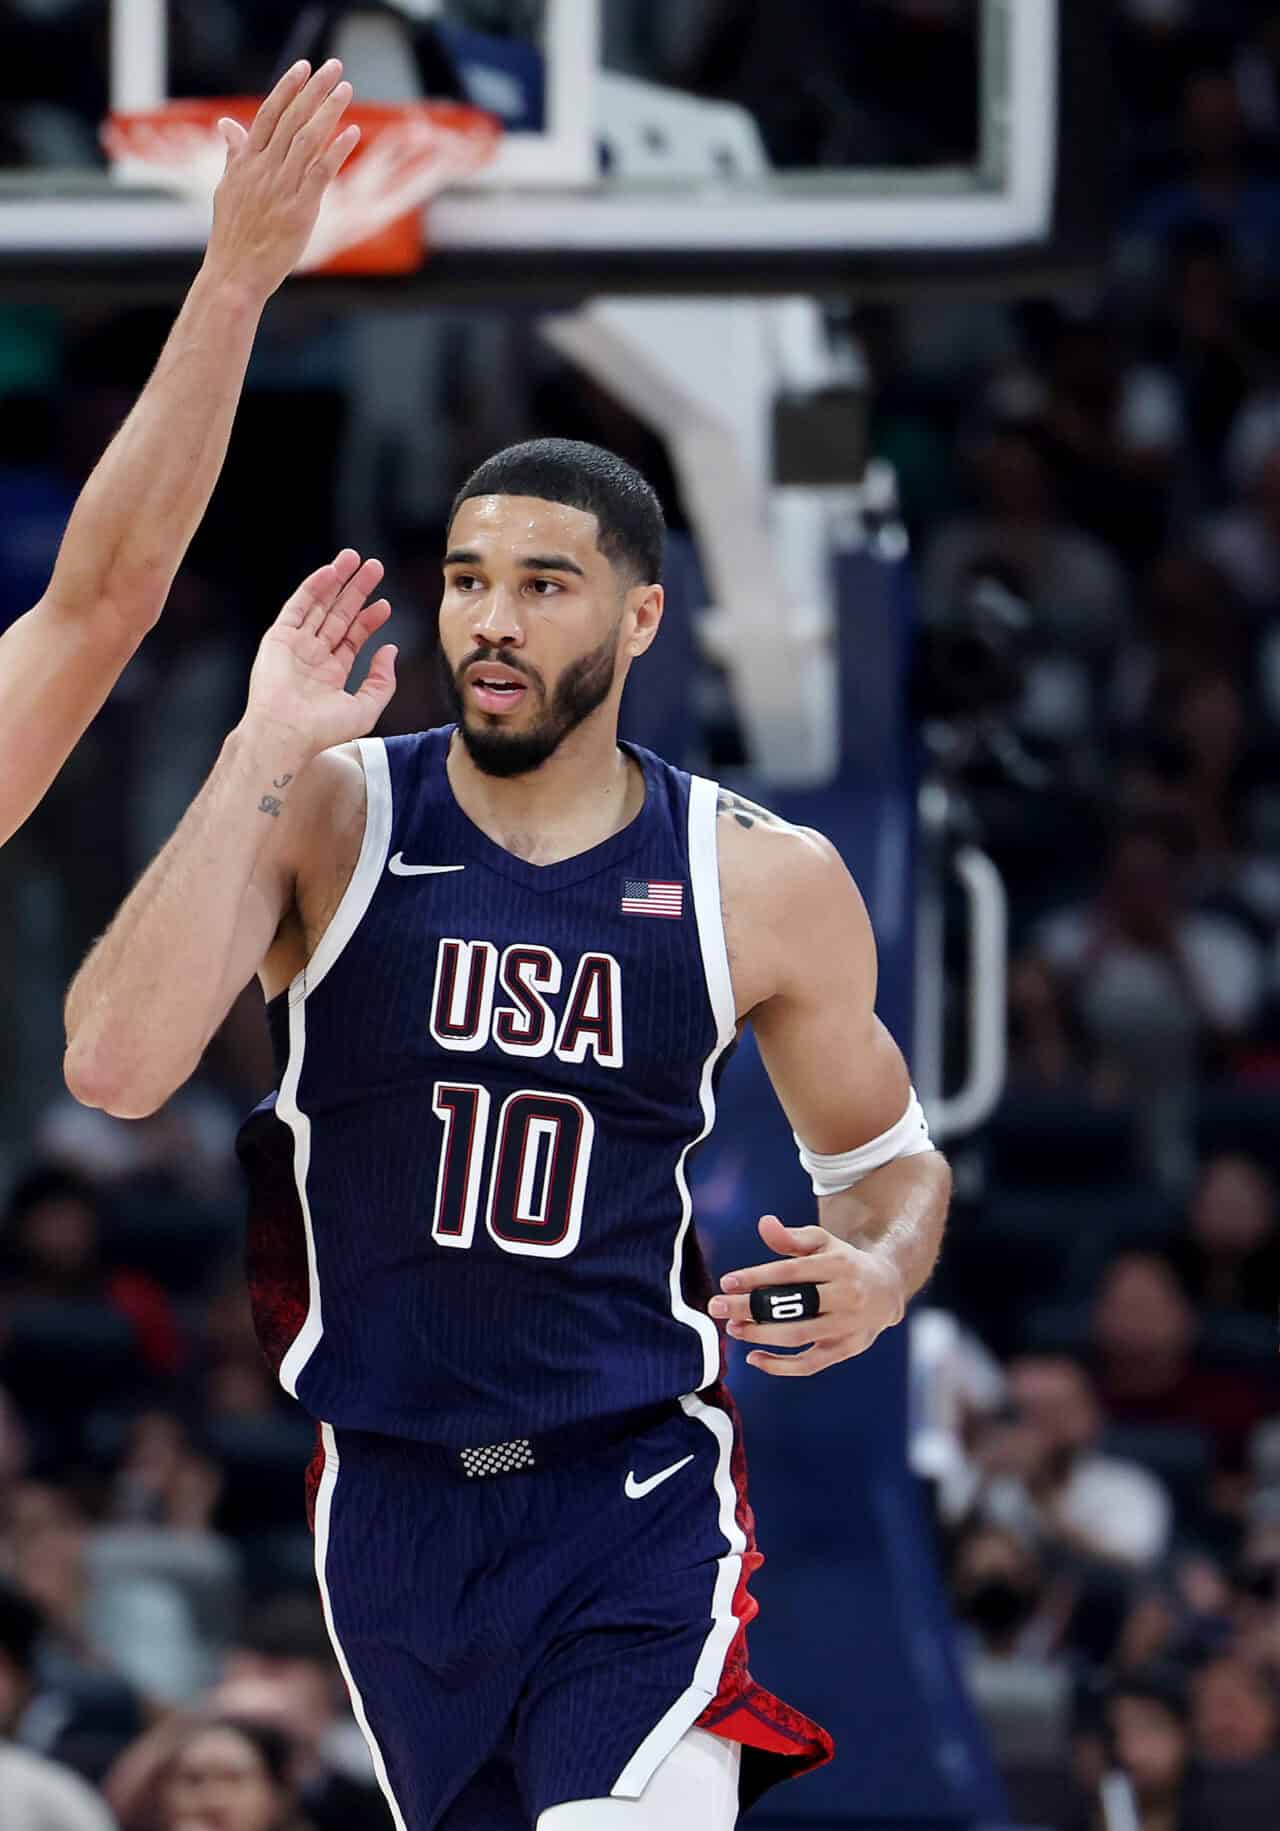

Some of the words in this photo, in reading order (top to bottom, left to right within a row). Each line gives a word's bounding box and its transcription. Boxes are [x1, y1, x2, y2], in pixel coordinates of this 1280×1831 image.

[429, 937, 624, 1069] USA
[432, 1081, 595, 1259] 10
[770, 1293, 804, 1319] 10
